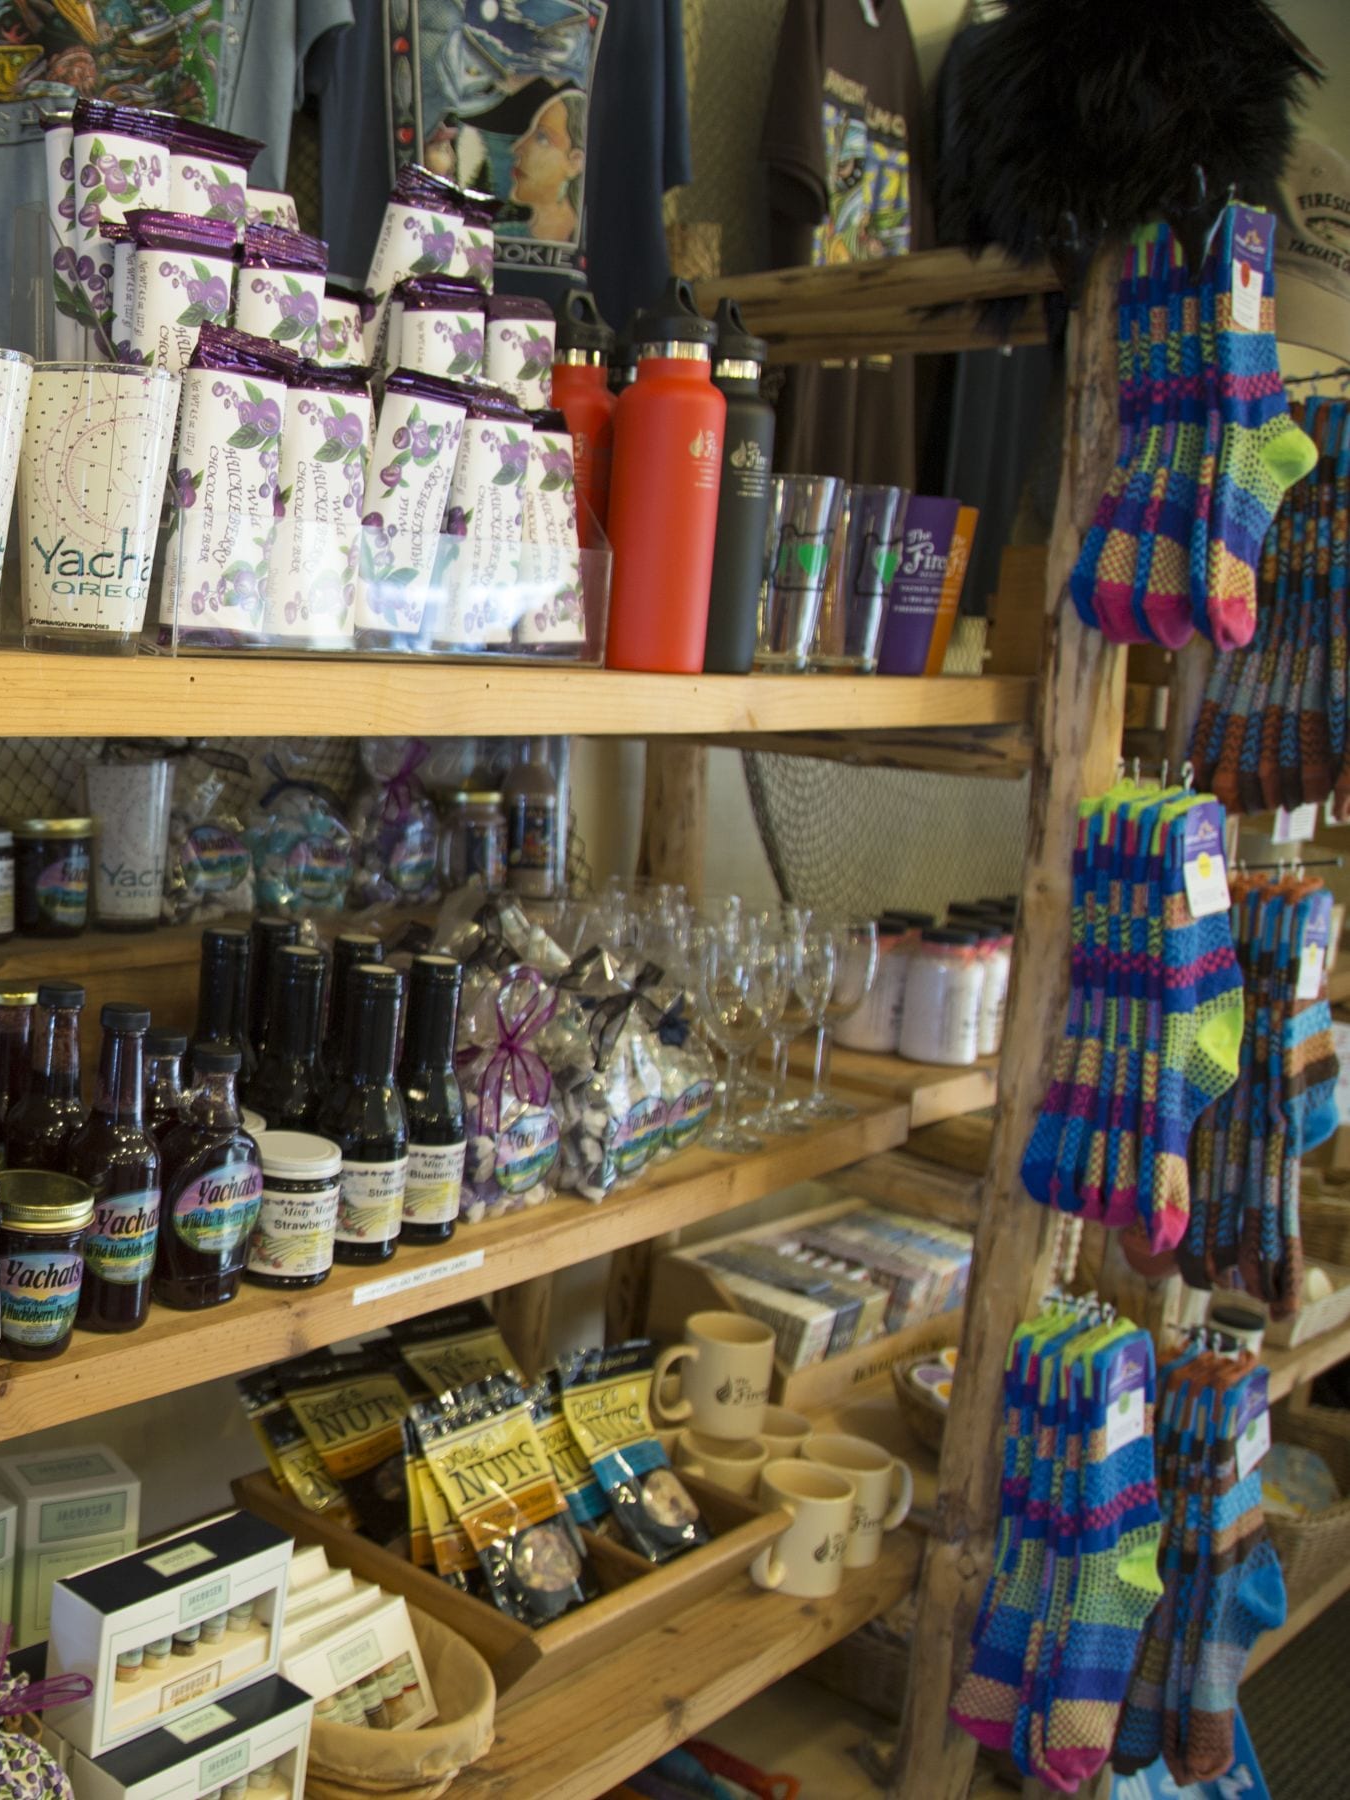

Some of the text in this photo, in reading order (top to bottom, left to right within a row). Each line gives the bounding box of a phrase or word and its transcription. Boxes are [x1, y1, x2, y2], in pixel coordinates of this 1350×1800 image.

[199, 1171, 258, 1206] Yachats
[6, 1256, 82, 1290] Yachats
[448, 1441, 541, 1505] NUTS
